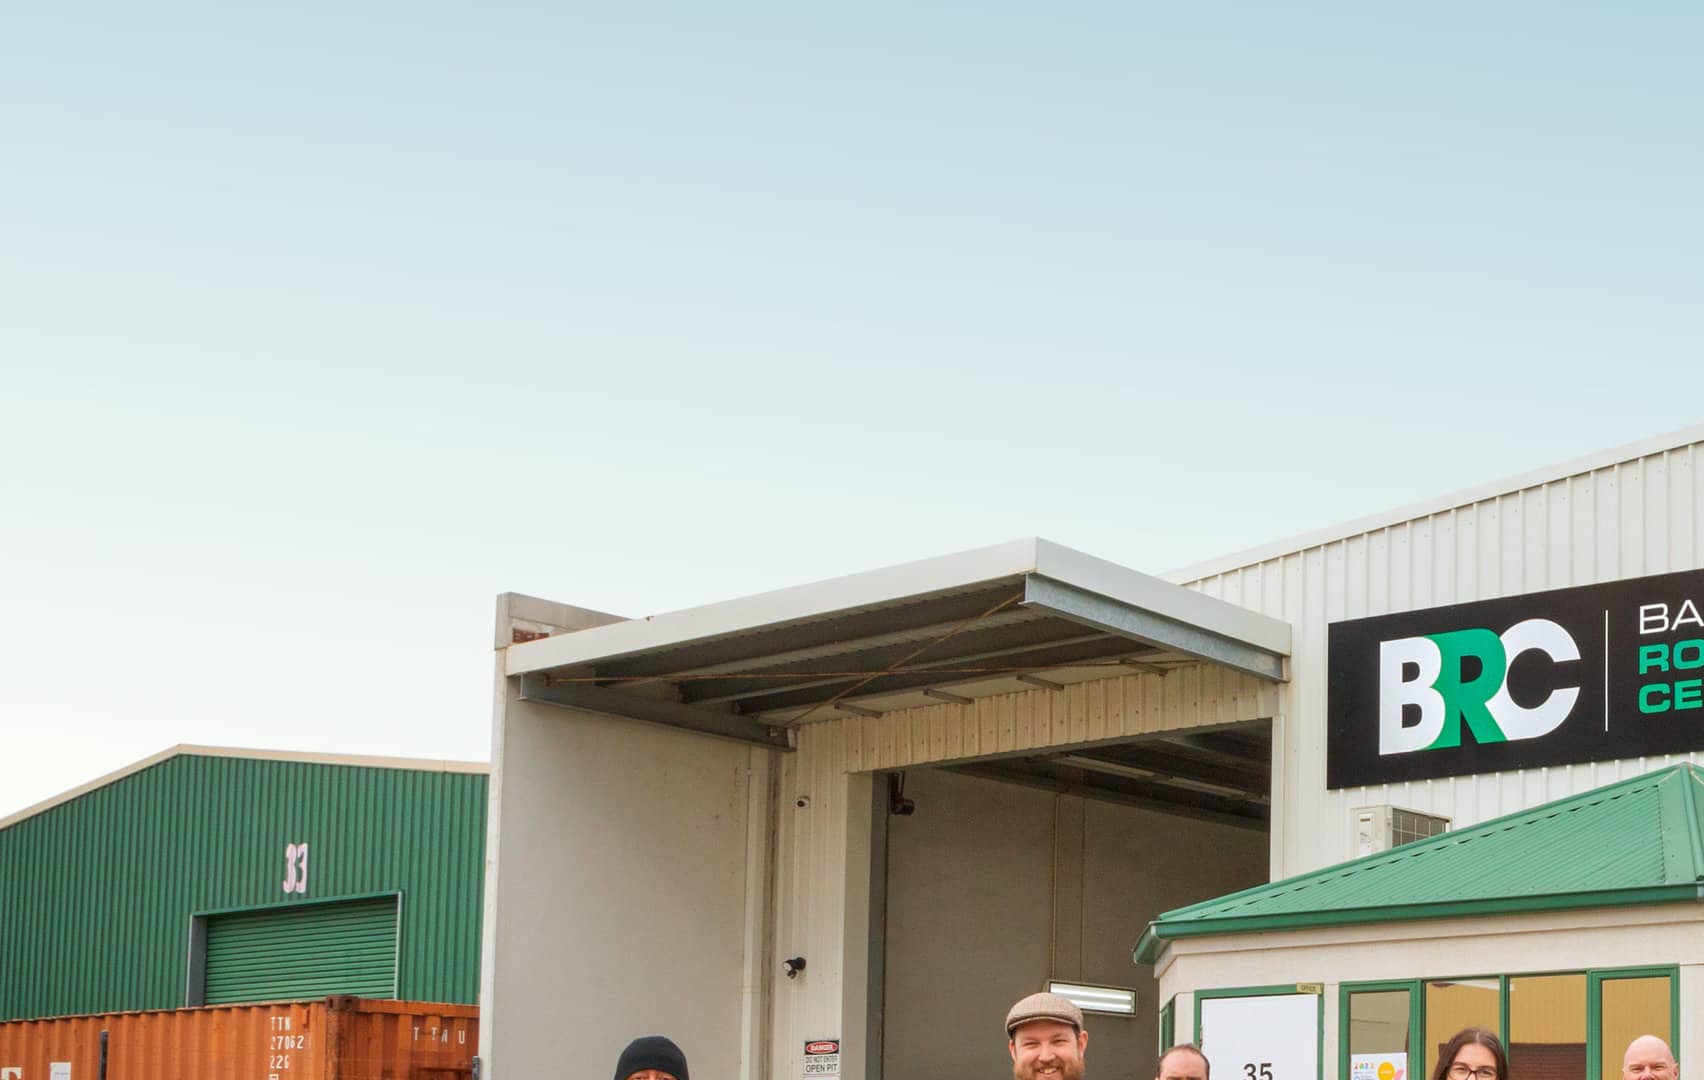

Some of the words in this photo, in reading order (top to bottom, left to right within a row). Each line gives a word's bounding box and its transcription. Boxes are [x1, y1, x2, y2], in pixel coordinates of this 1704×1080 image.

[1379, 618, 1581, 756] BRC
[283, 843, 308, 893] 33
[806, 1064, 825, 1072] OPEN
[827, 1063, 837, 1072] PIT
